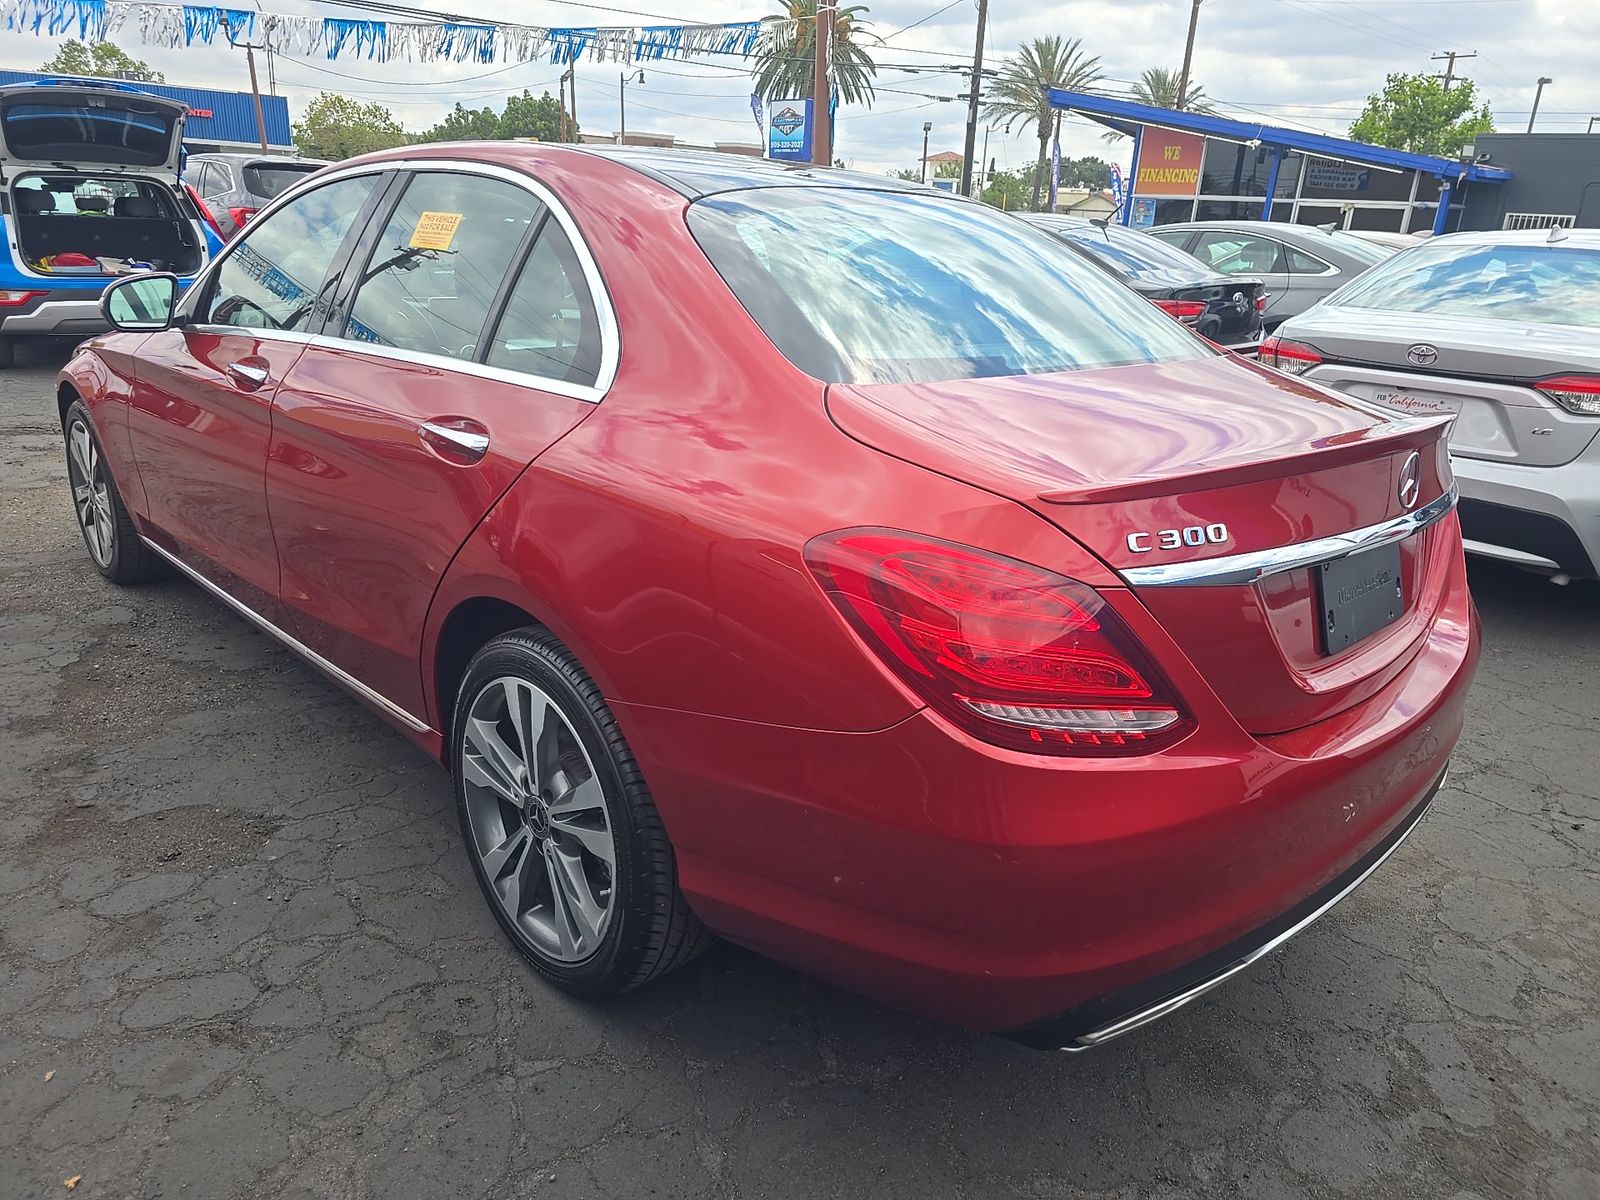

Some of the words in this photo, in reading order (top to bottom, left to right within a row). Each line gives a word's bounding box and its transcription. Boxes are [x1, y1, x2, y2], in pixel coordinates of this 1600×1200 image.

[1164, 146, 1181, 160] WE
[1139, 168, 1198, 183] FINANCING
[436, 215, 459, 224] VEHICLE
[1376, 393, 1387, 401] FEB
[1126, 531, 1153, 553] C
[1156, 522, 1229, 550] 300
